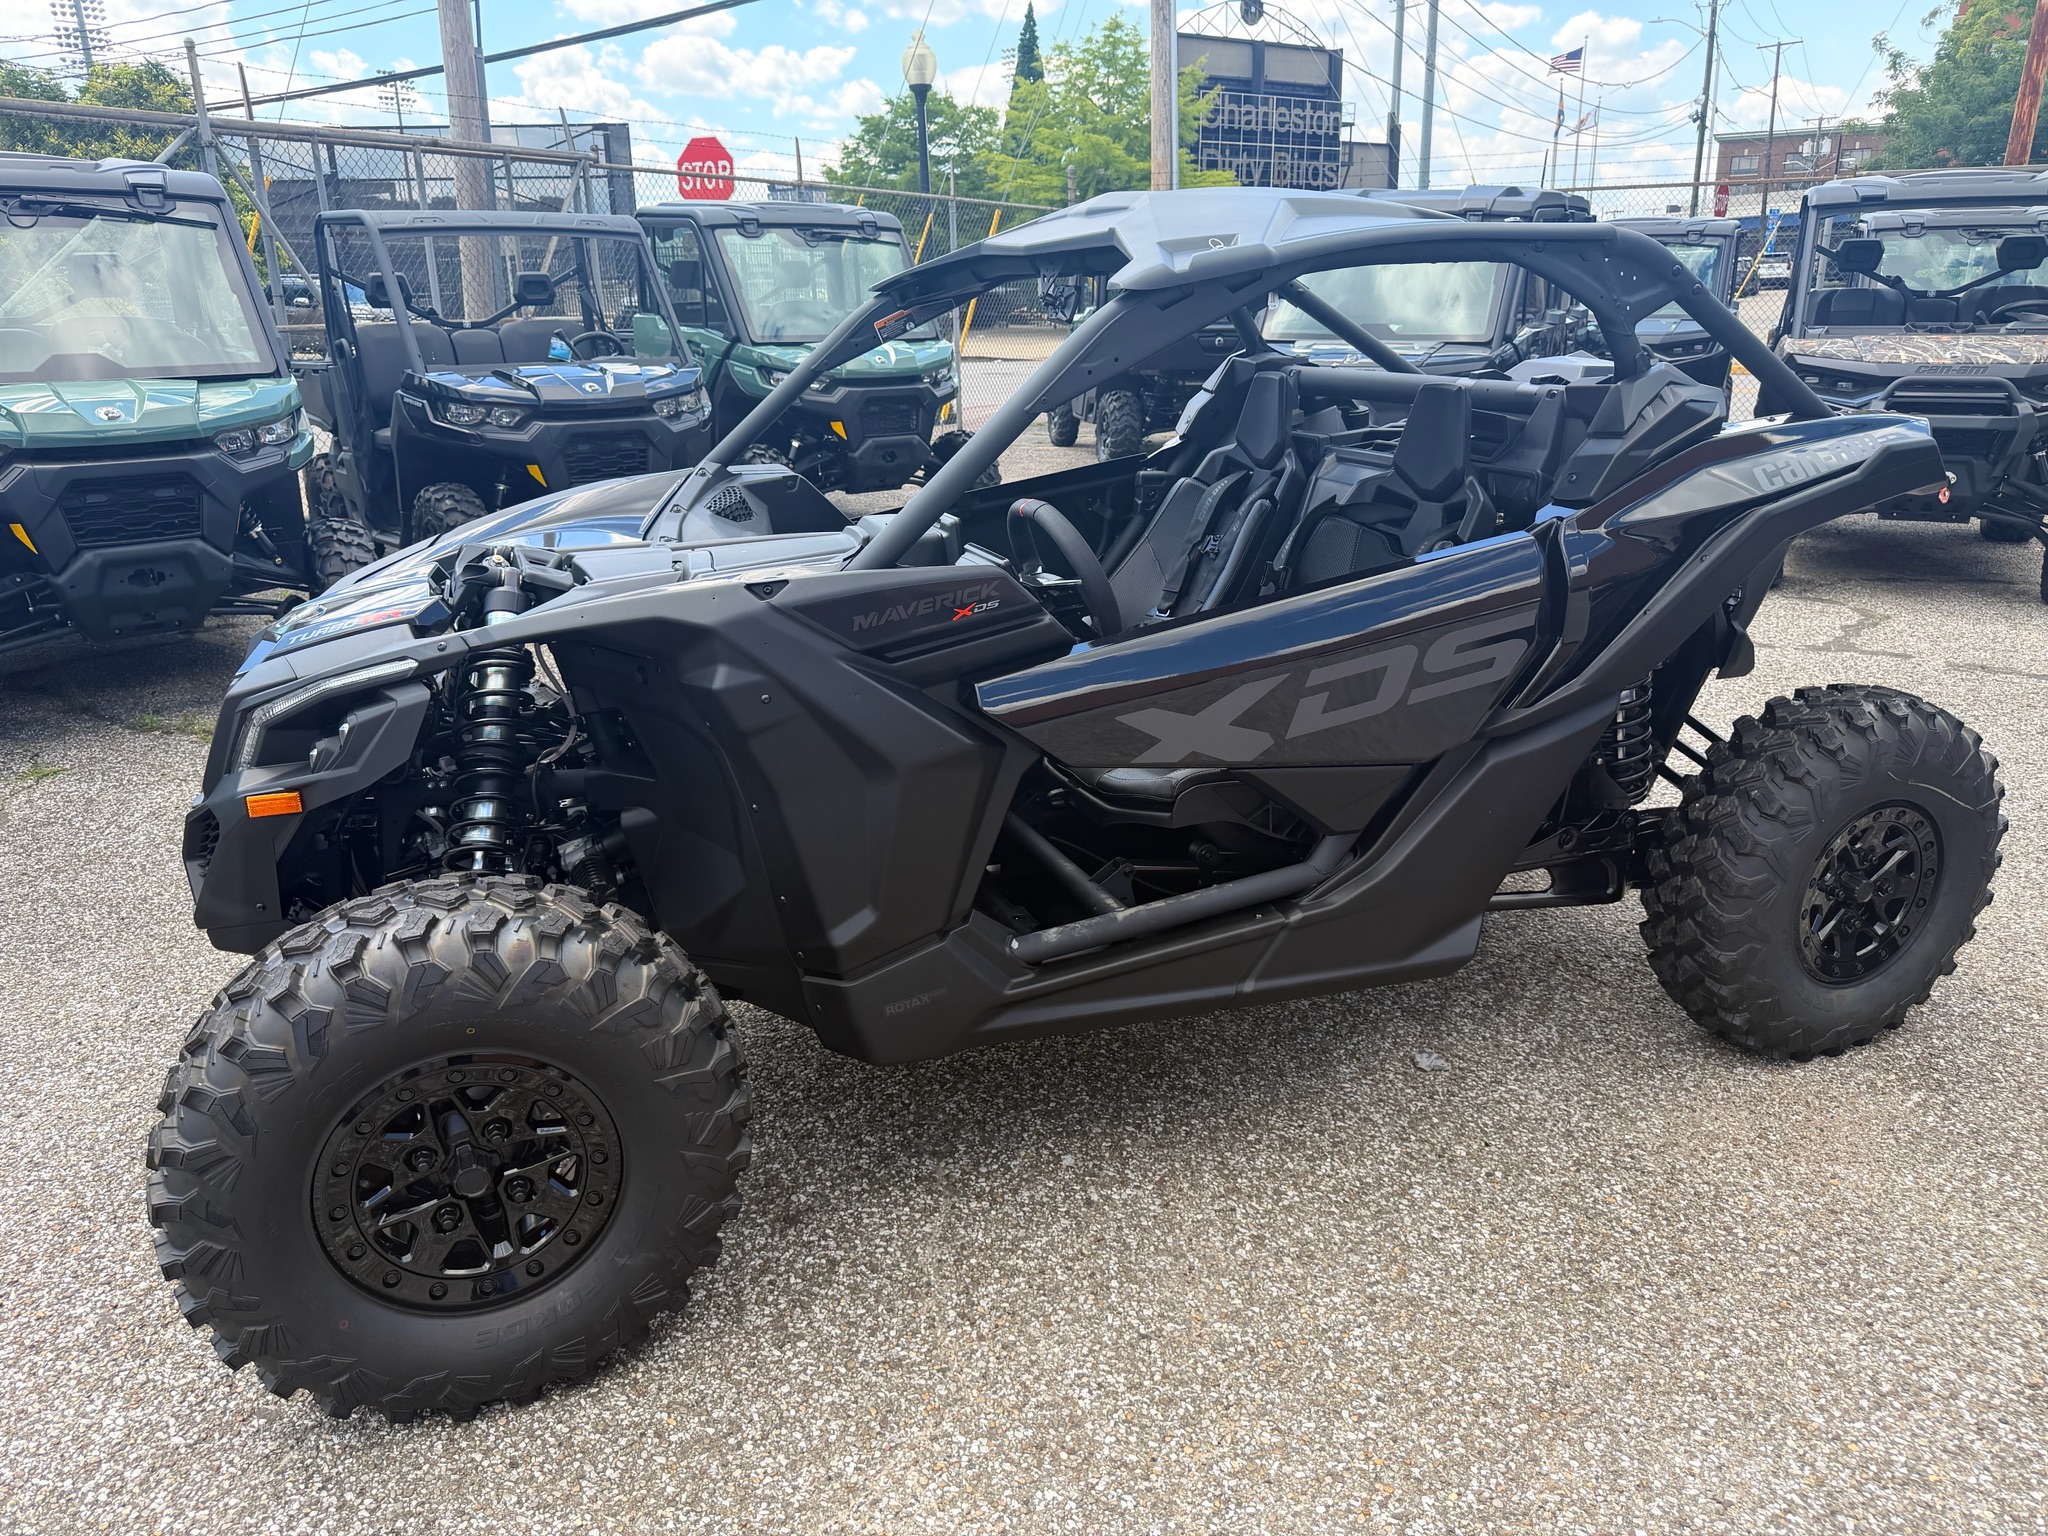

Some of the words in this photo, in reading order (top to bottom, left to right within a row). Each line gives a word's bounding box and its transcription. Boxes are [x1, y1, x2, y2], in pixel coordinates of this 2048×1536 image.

[1203, 93, 1341, 136] Charleston
[681, 160, 731, 191] STOP
[1202, 148, 1266, 187] Dirty
[1274, 150, 1338, 187] Birds
[852, 579, 1001, 632] MAVERICK
[953, 599, 1001, 622] XDS
[288, 619, 357, 645] TURBO
[1115, 610, 1538, 763] XDS
[885, 993, 930, 1016] ROTAX
